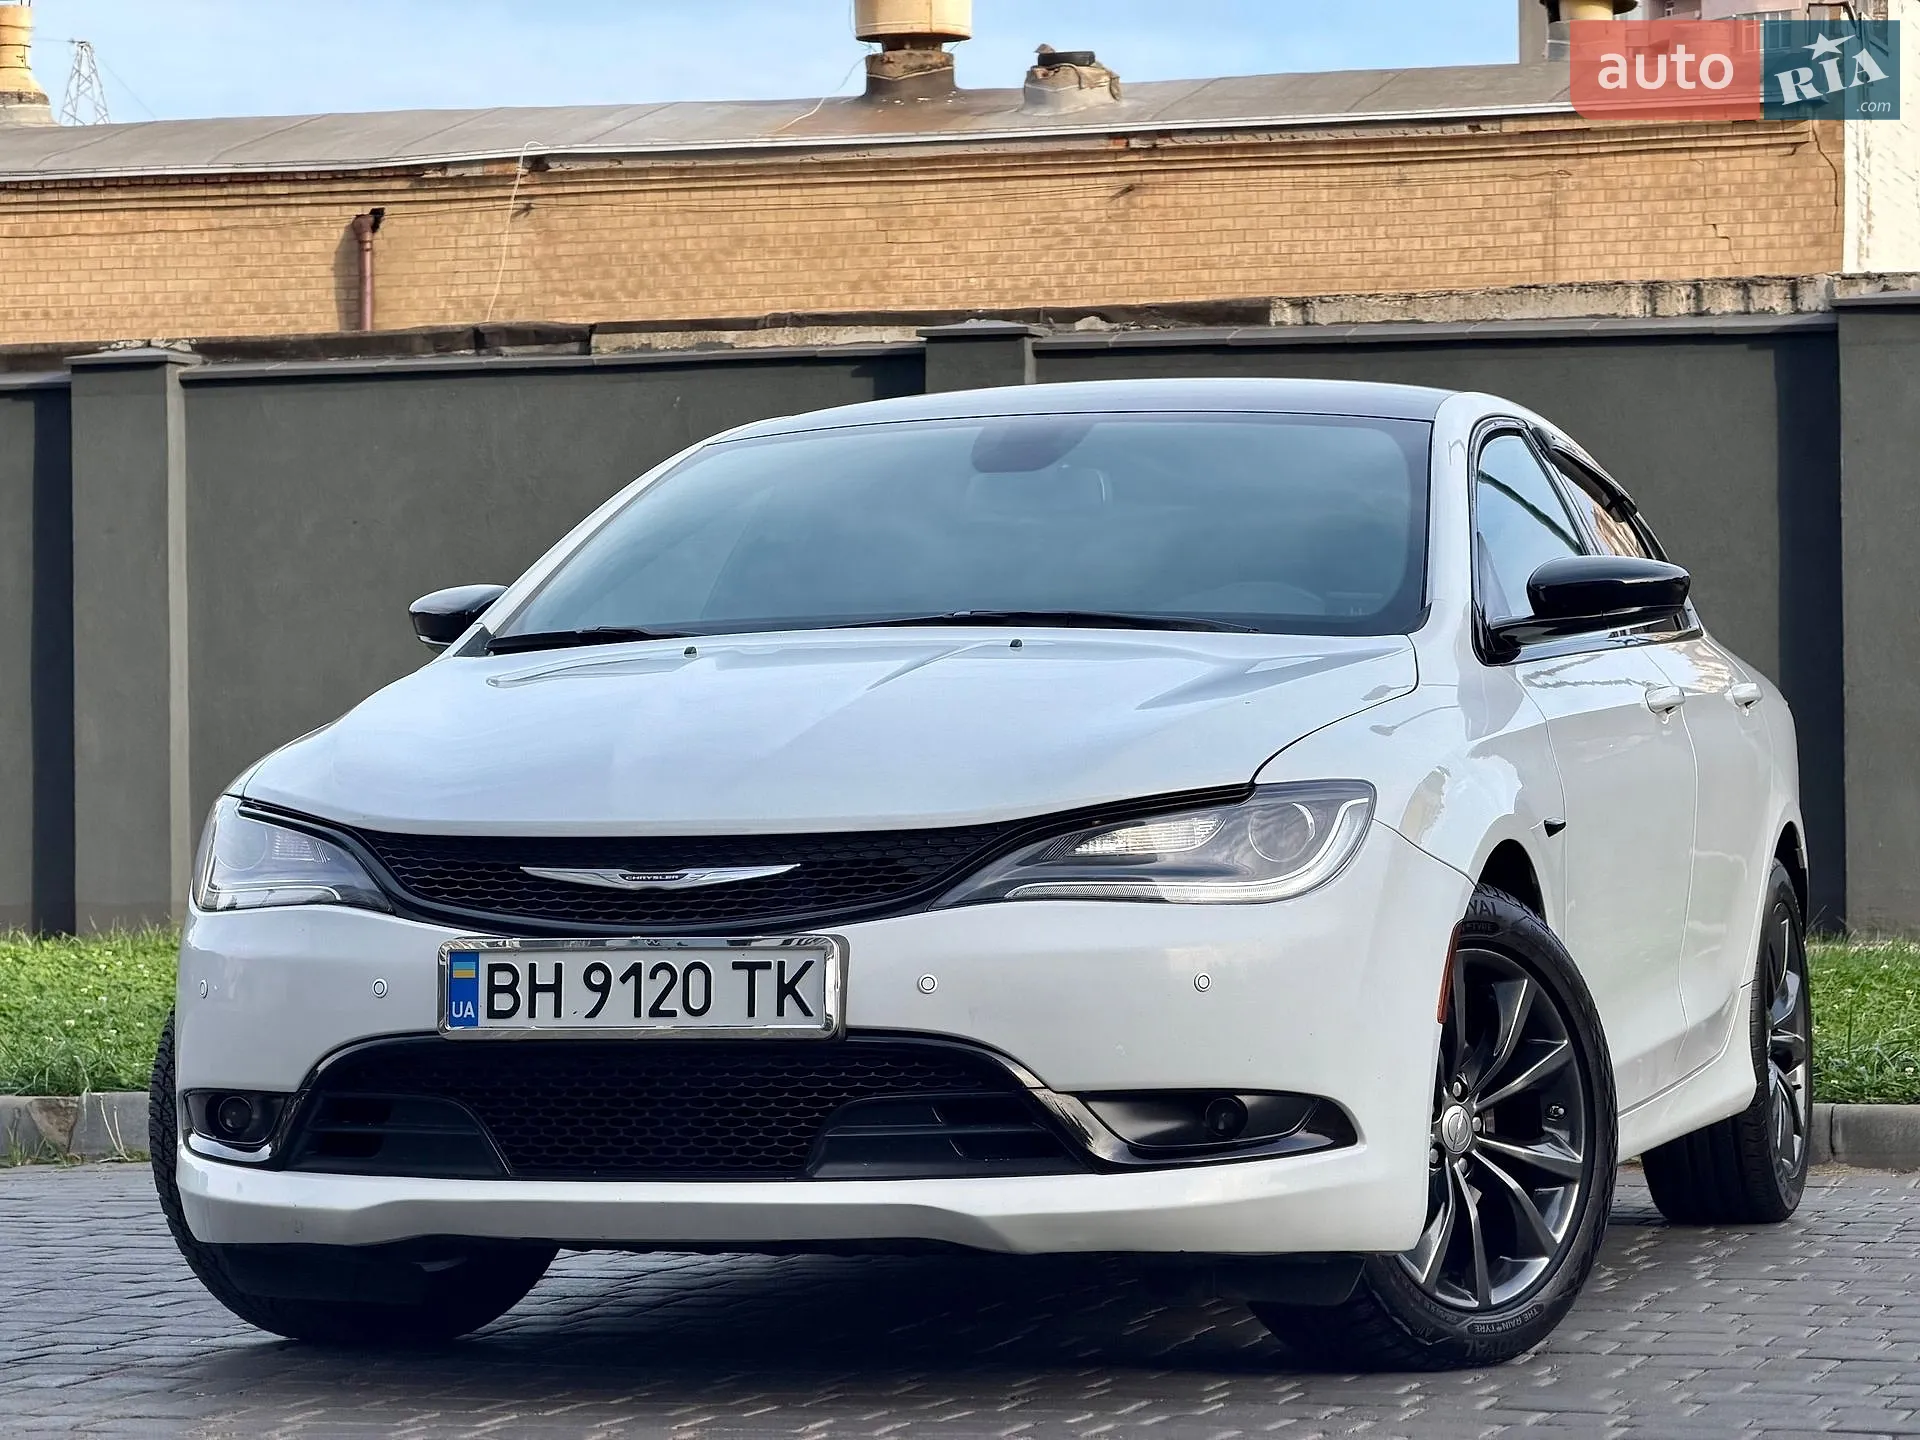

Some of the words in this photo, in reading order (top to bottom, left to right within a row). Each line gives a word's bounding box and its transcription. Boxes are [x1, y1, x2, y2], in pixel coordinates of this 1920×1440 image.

[486, 962, 563, 1019] BH
[582, 961, 713, 1019] 9120
[731, 960, 815, 1018] TK
[452, 1000, 476, 1019] UA
[1521, 1307, 1540, 1322] THE
[1474, 1324, 1497, 1334] TYRE
